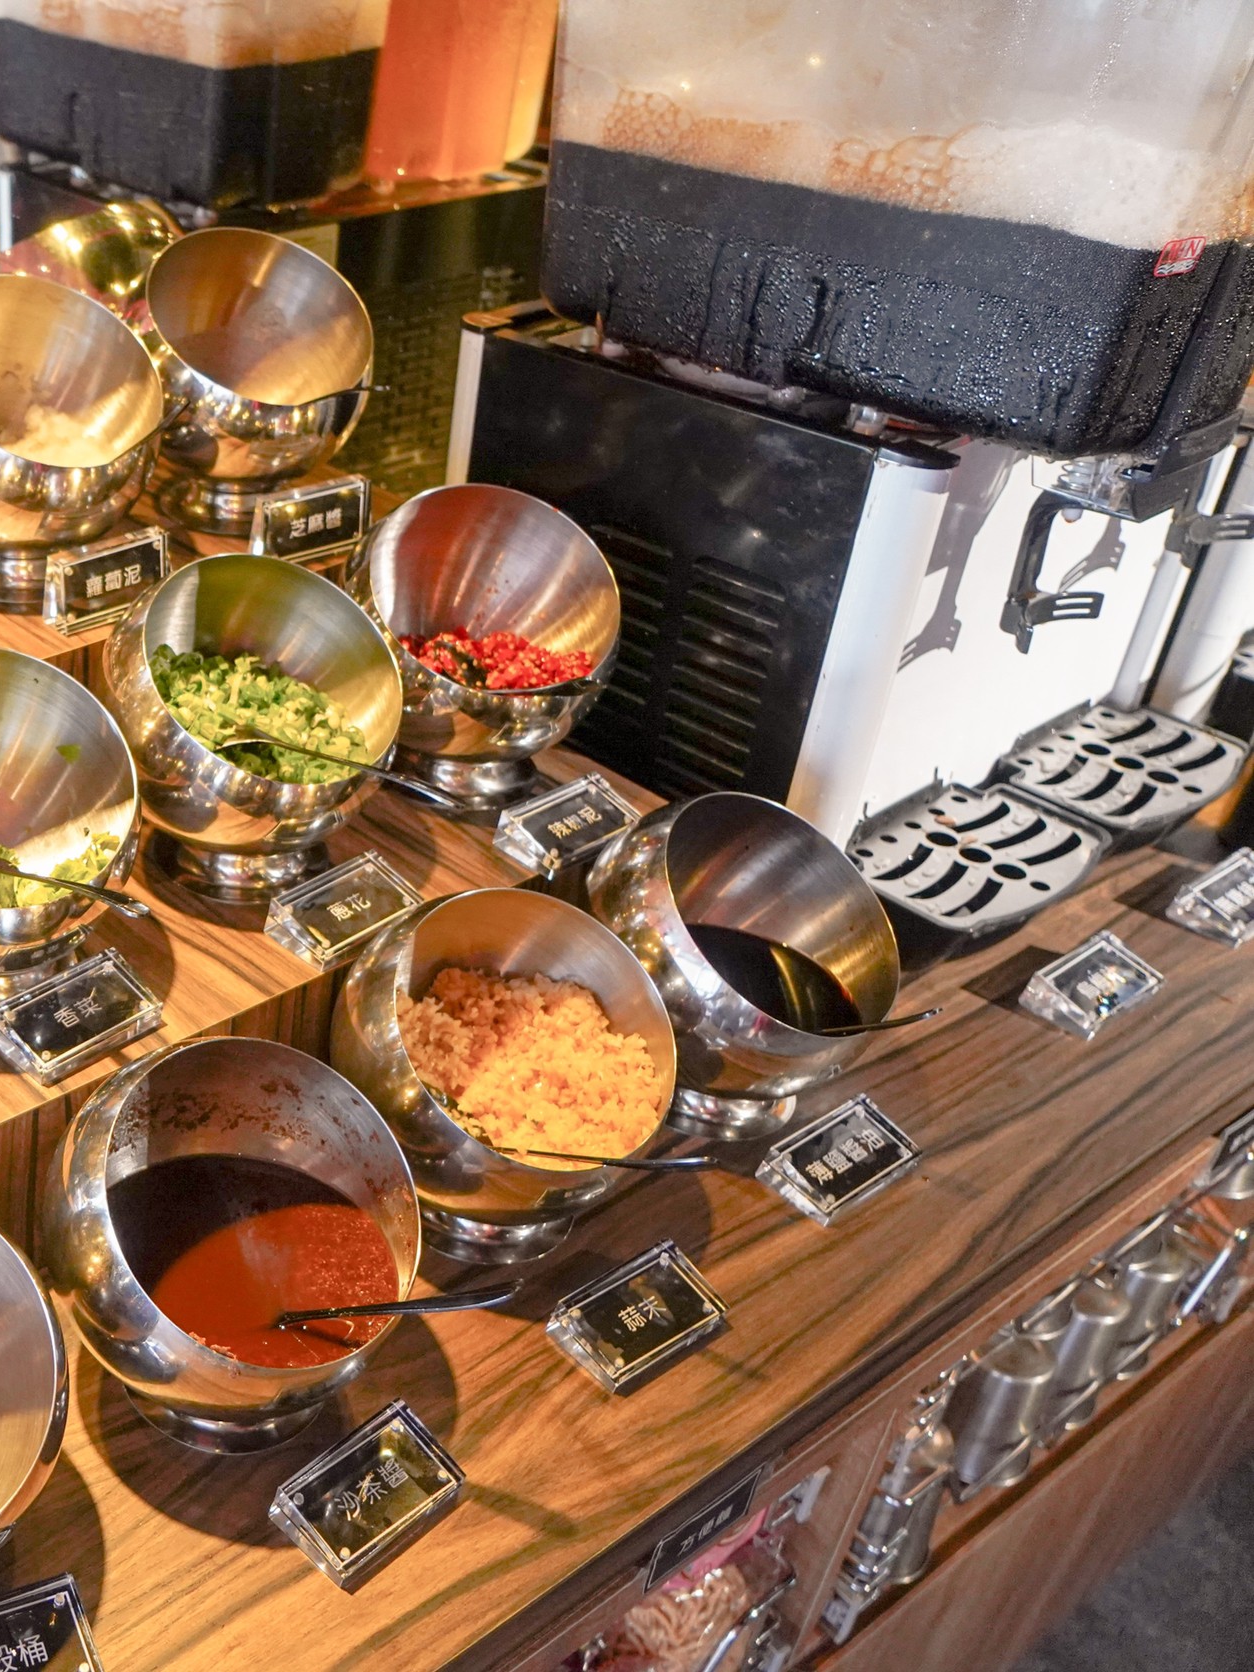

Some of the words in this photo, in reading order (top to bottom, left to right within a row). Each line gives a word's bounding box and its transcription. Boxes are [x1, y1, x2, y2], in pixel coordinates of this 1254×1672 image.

[289, 507, 343, 540] 芝麻醬
[53, 997, 104, 1029] 香菜
[618, 1295, 668, 1334] 蒜末
[334, 1457, 409, 1522] 沙茶醬
